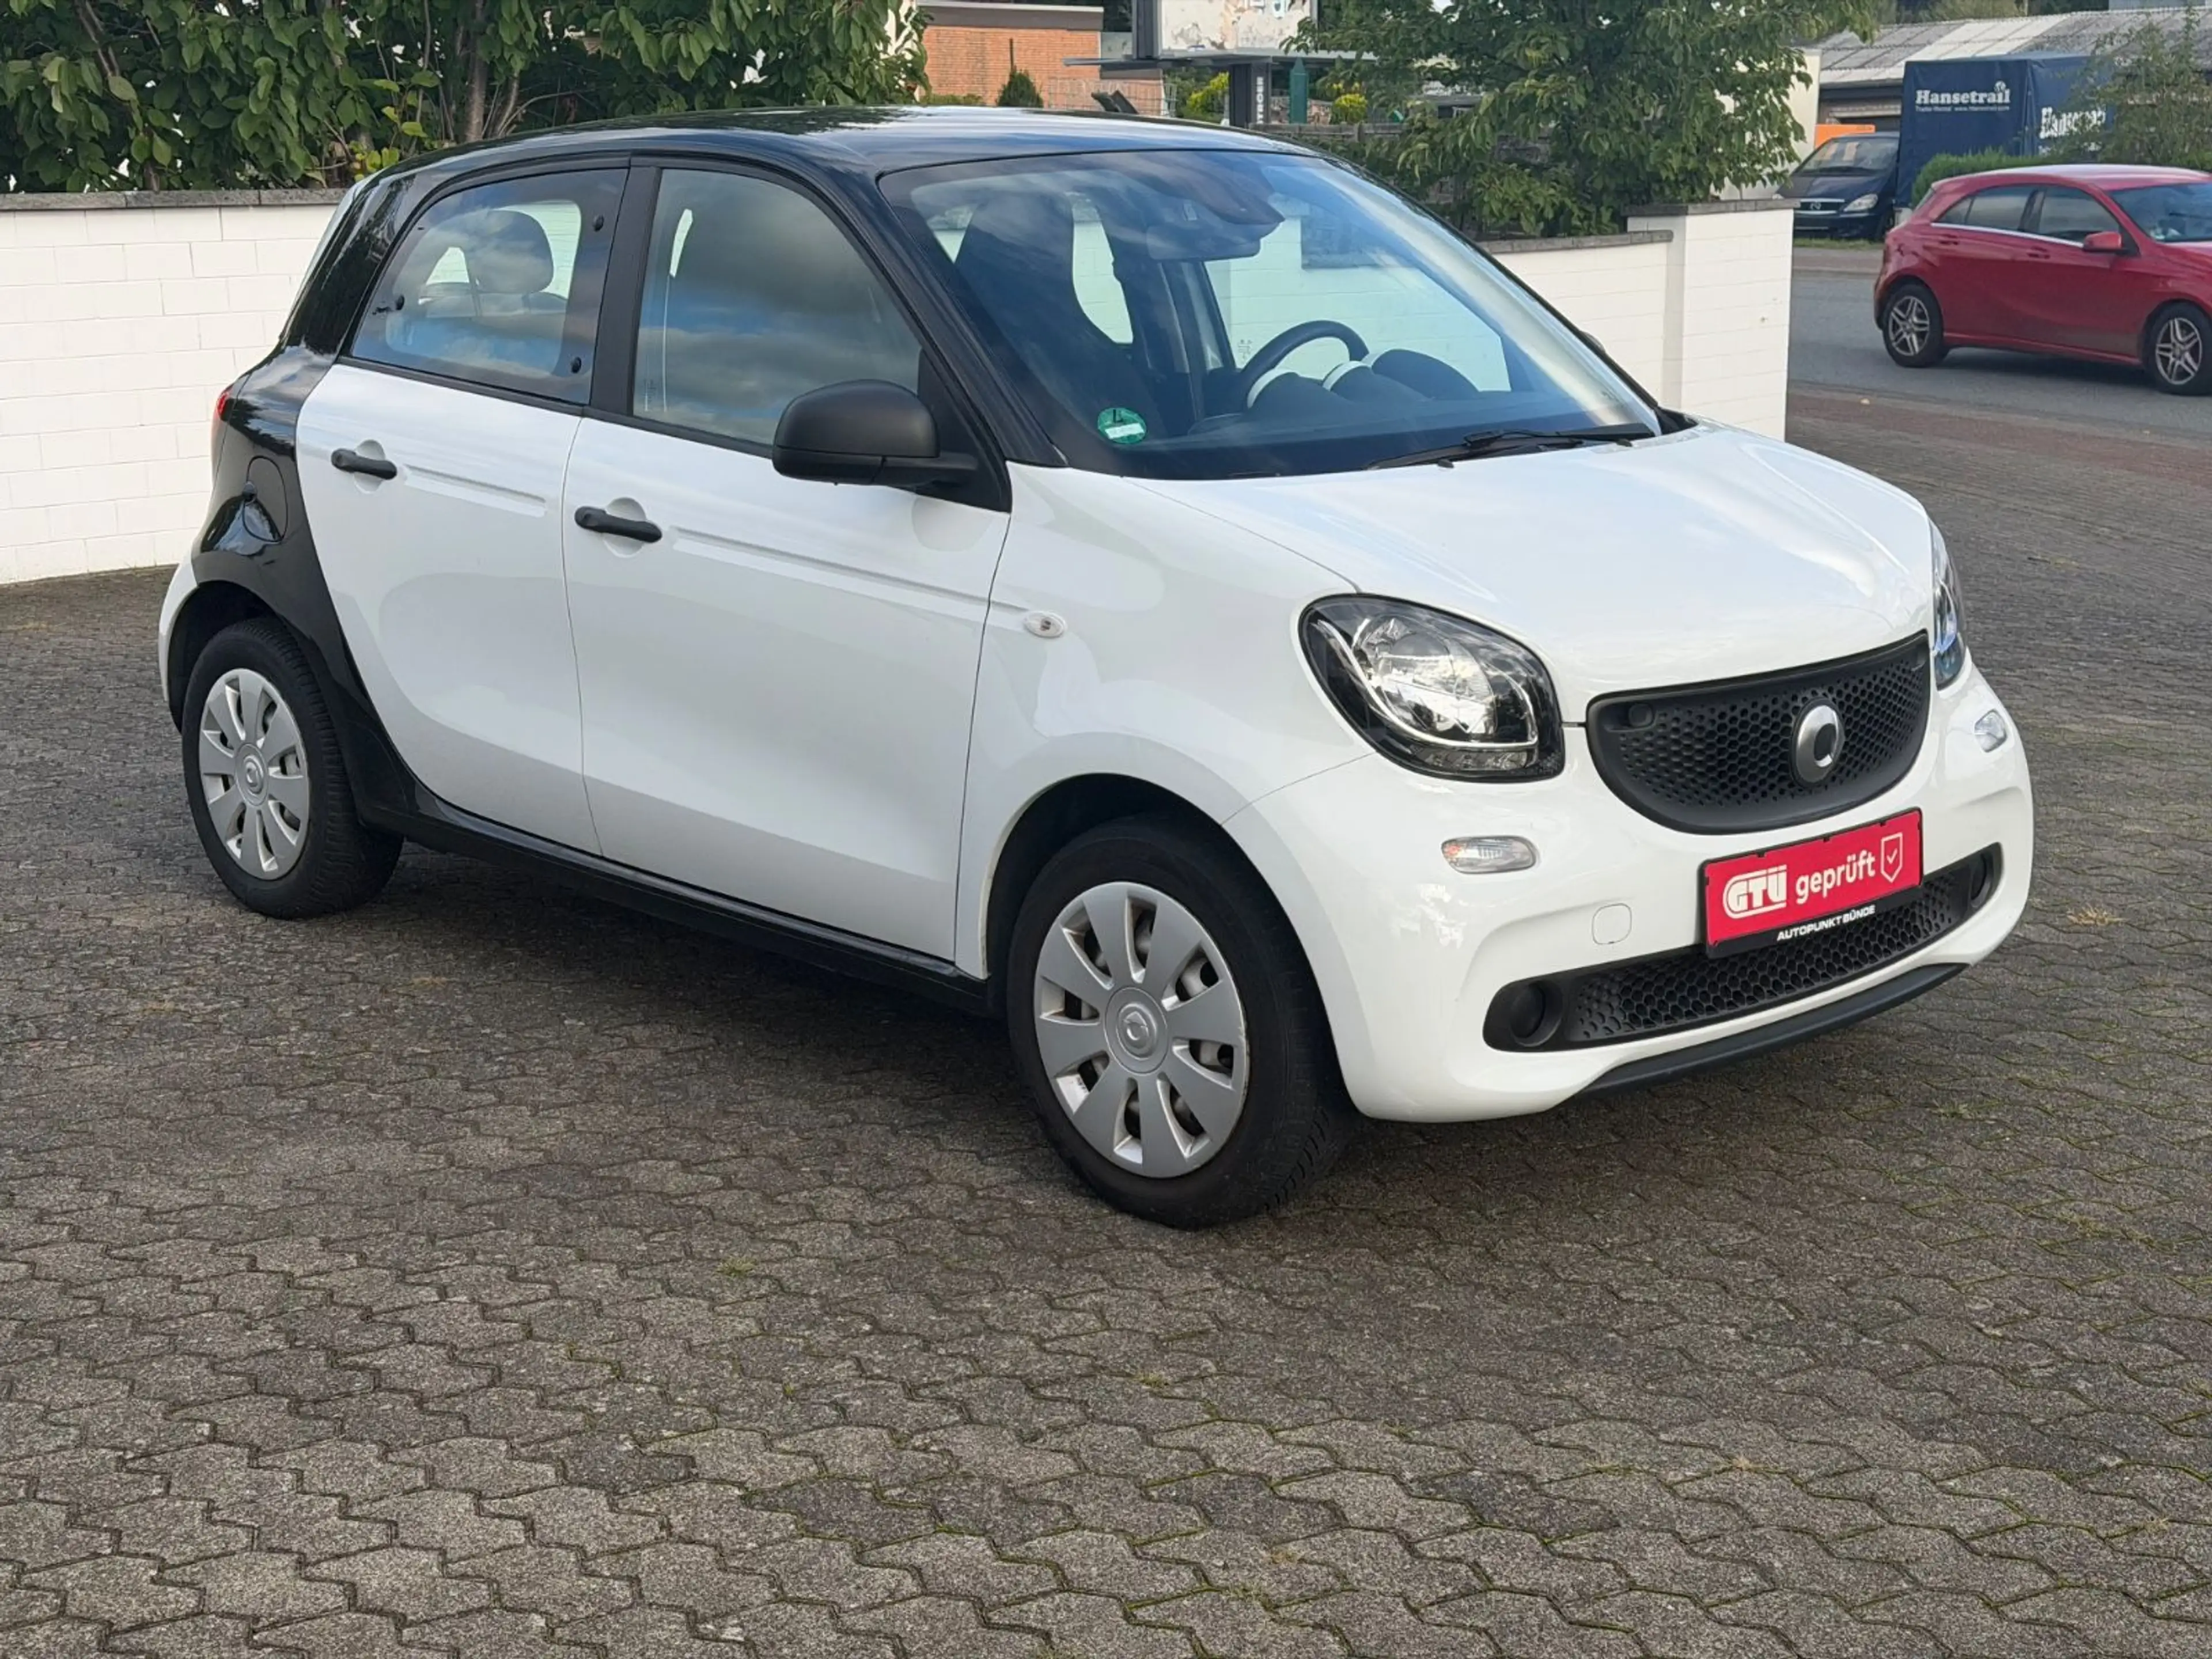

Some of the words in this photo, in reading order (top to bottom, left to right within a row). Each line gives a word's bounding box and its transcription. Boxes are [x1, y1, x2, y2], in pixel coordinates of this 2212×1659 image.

[1915, 88, 2011, 105] Hansetrail
[1724, 865, 1787, 918] GTÜ
[1796, 850, 1876, 905] geprüft
[1777, 916, 1842, 941] AUTOPUNKT
[1843, 904, 1876, 923] BÜNDE
